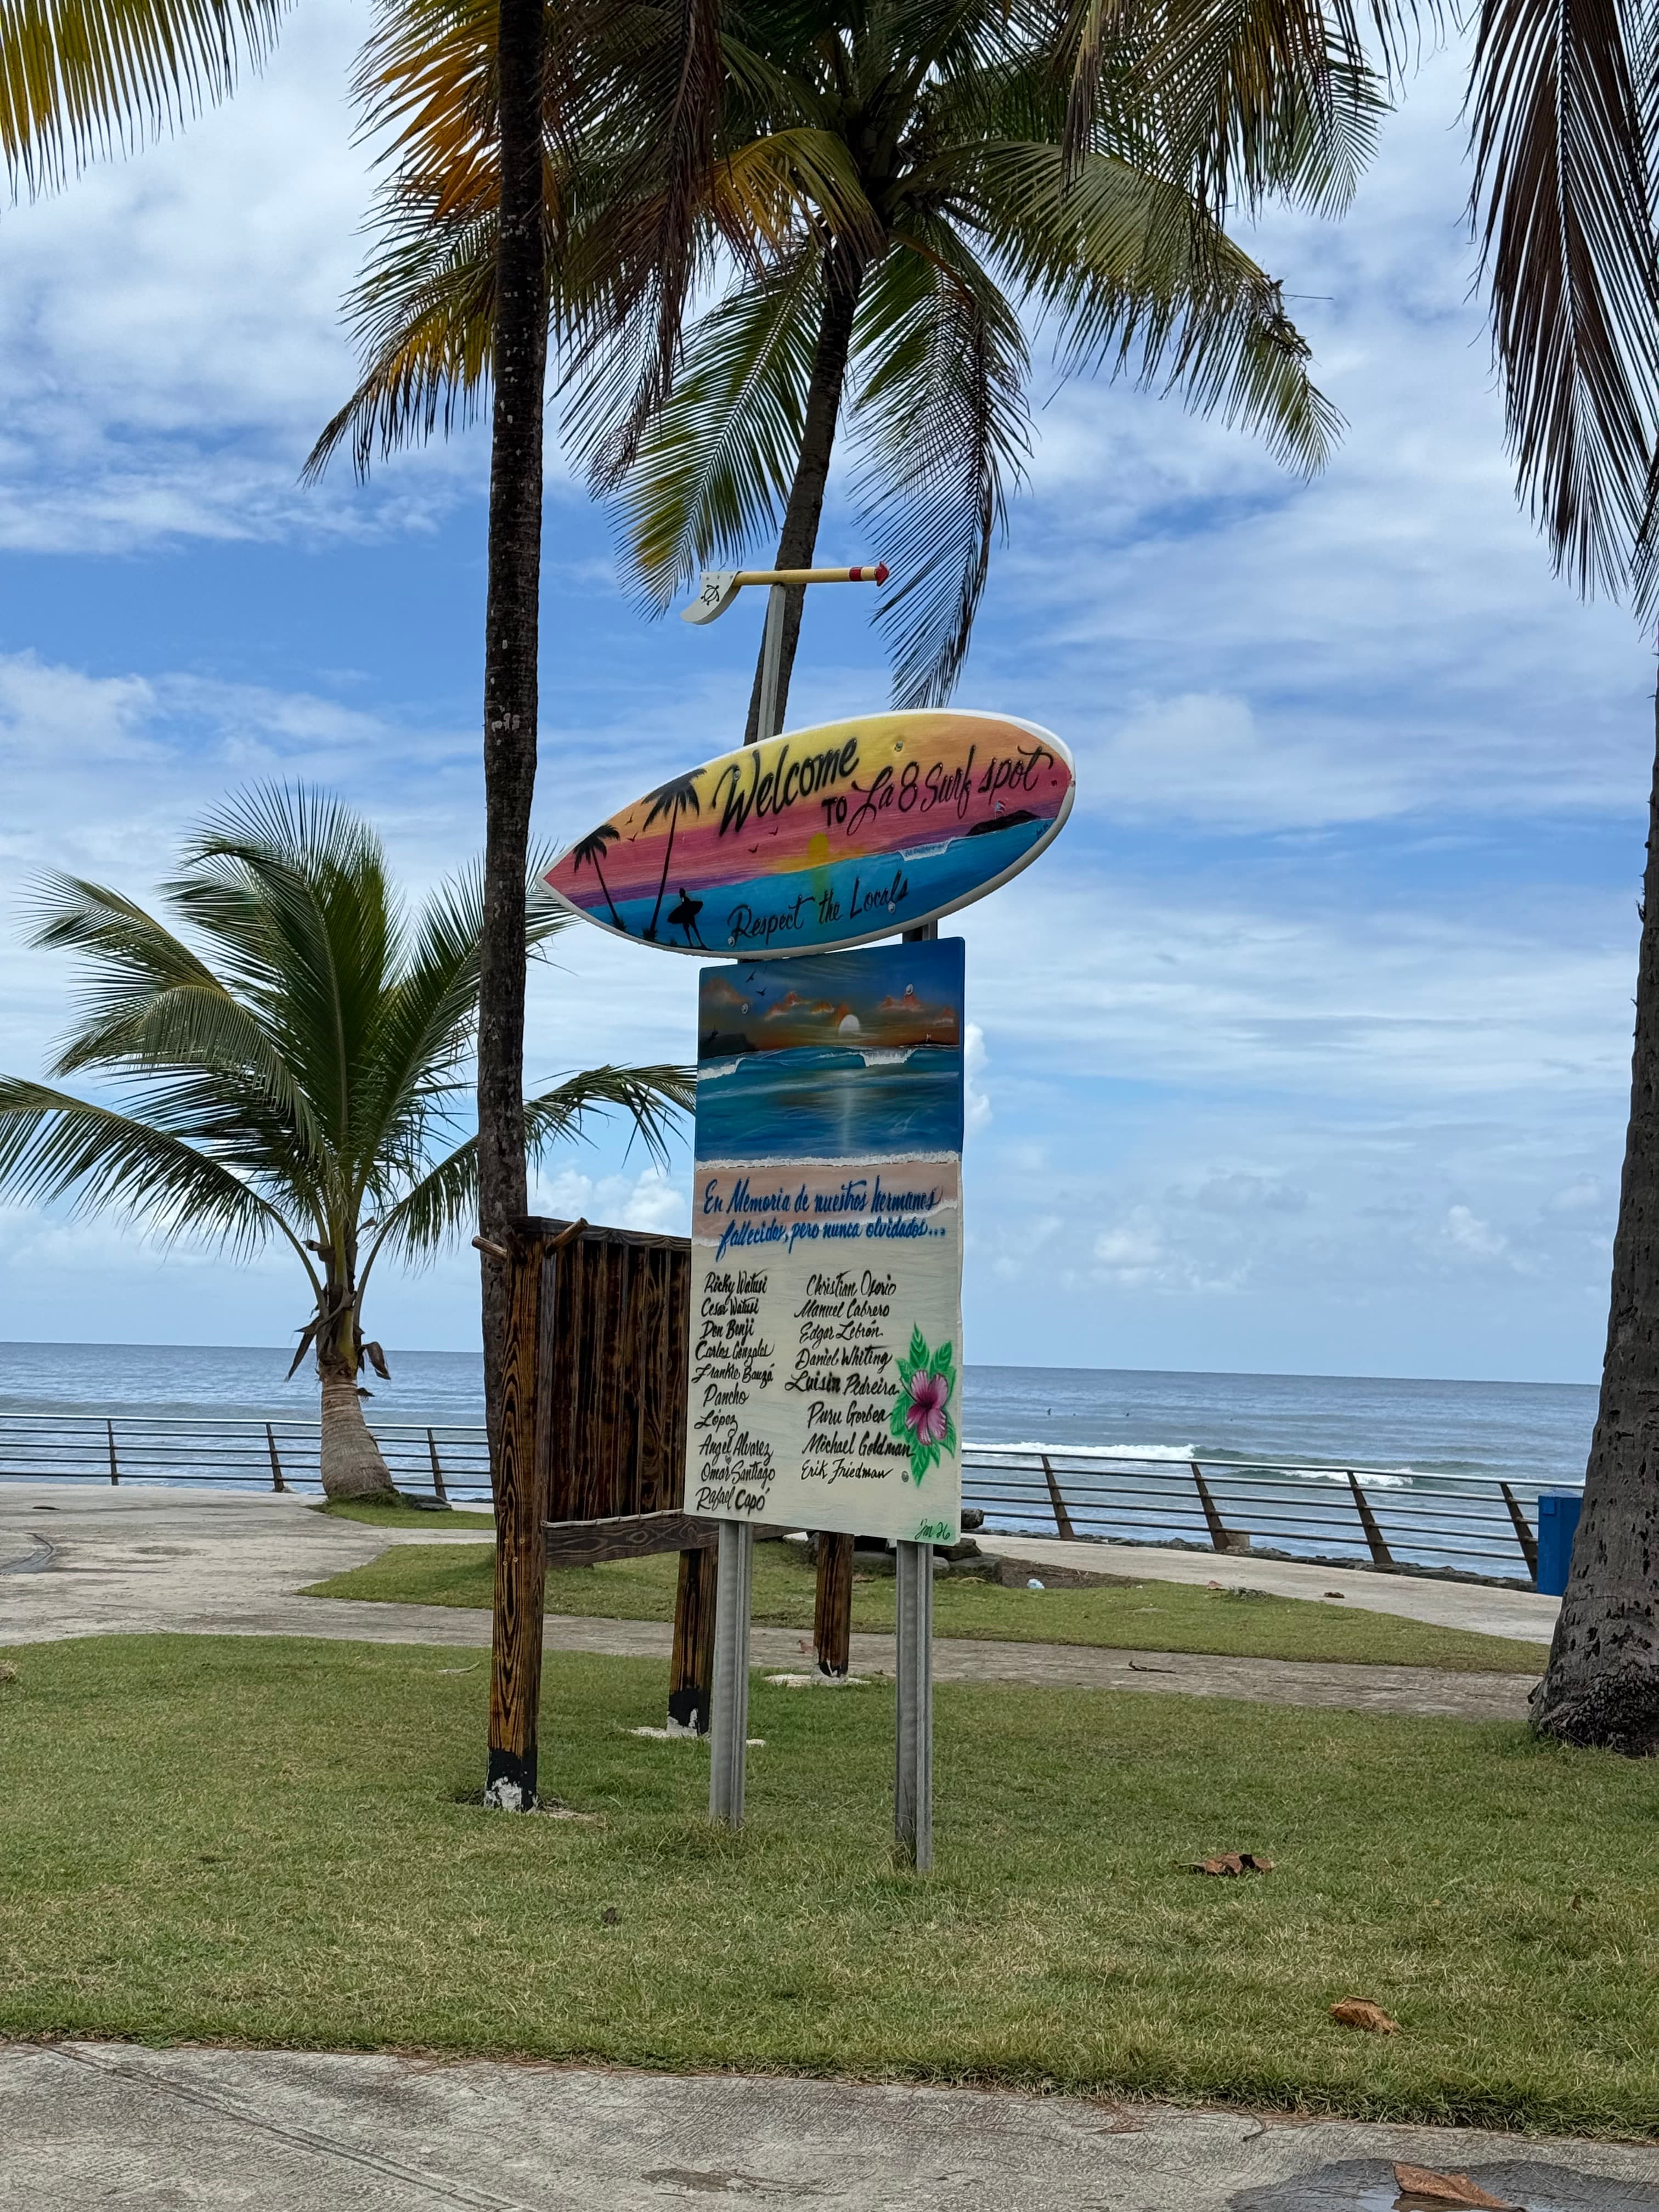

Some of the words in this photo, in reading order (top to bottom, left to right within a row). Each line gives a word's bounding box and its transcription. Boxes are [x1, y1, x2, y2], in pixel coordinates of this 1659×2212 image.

[712, 737, 860, 837] Welcome
[847, 766, 893, 836] La
[898, 761, 919, 812] 8
[921, 744, 976, 819] Surf
[727, 894, 816, 946] Respect
[819, 888, 844, 924] the
[850, 870, 909, 919] Locals
[703, 1178, 723, 1214] En
[726, 1176, 791, 1214] Memoria
[794, 1183, 810, 1213] de
[815, 1180, 868, 1212] nuestros
[871, 1175, 944, 1213] hermanos
[788, 1222, 820, 1254] pero
[823, 1222, 864, 1239] nunca
[704, 1271, 735, 1305] Ricky
[736, 1268, 769, 1295] Watusi
[806, 1269, 857, 1297] Christian
[701, 1297, 729, 1317] Cesar
[730, 1296, 759, 1316] Watusi
[794, 1299, 845, 1318] Manuel
[699, 1320, 724, 1339] Don
[725, 1318, 754, 1346] Benji
[799, 1321, 834, 1350] Edgar
[836, 1319, 883, 1340] Lebrón
[695, 1340, 732, 1361] Carlos
[795, 1347, 839, 1370] Daniel
[841, 1345, 893, 1374] Whiting
[691, 1362, 740, 1384] Frankie
[842, 1372, 900, 1396] Pedreira
[703, 1381, 750, 1407] Pancho
[694, 1408, 738, 1438] López
[698, 1433, 732, 1466] Angel
[732, 1431, 774, 1466] Alvarez
[802, 1430, 856, 1454] Michael
[859, 1430, 916, 1458] Goldman
[701, 1462, 731, 1481] Omar
[731, 1459, 775, 1490] Santiago
[801, 1459, 828, 1480] Erik
[827, 1458, 894, 1485] Friedman
[695, 1485, 736, 1511] Rafael
[735, 1487, 770, 1517] Capó
